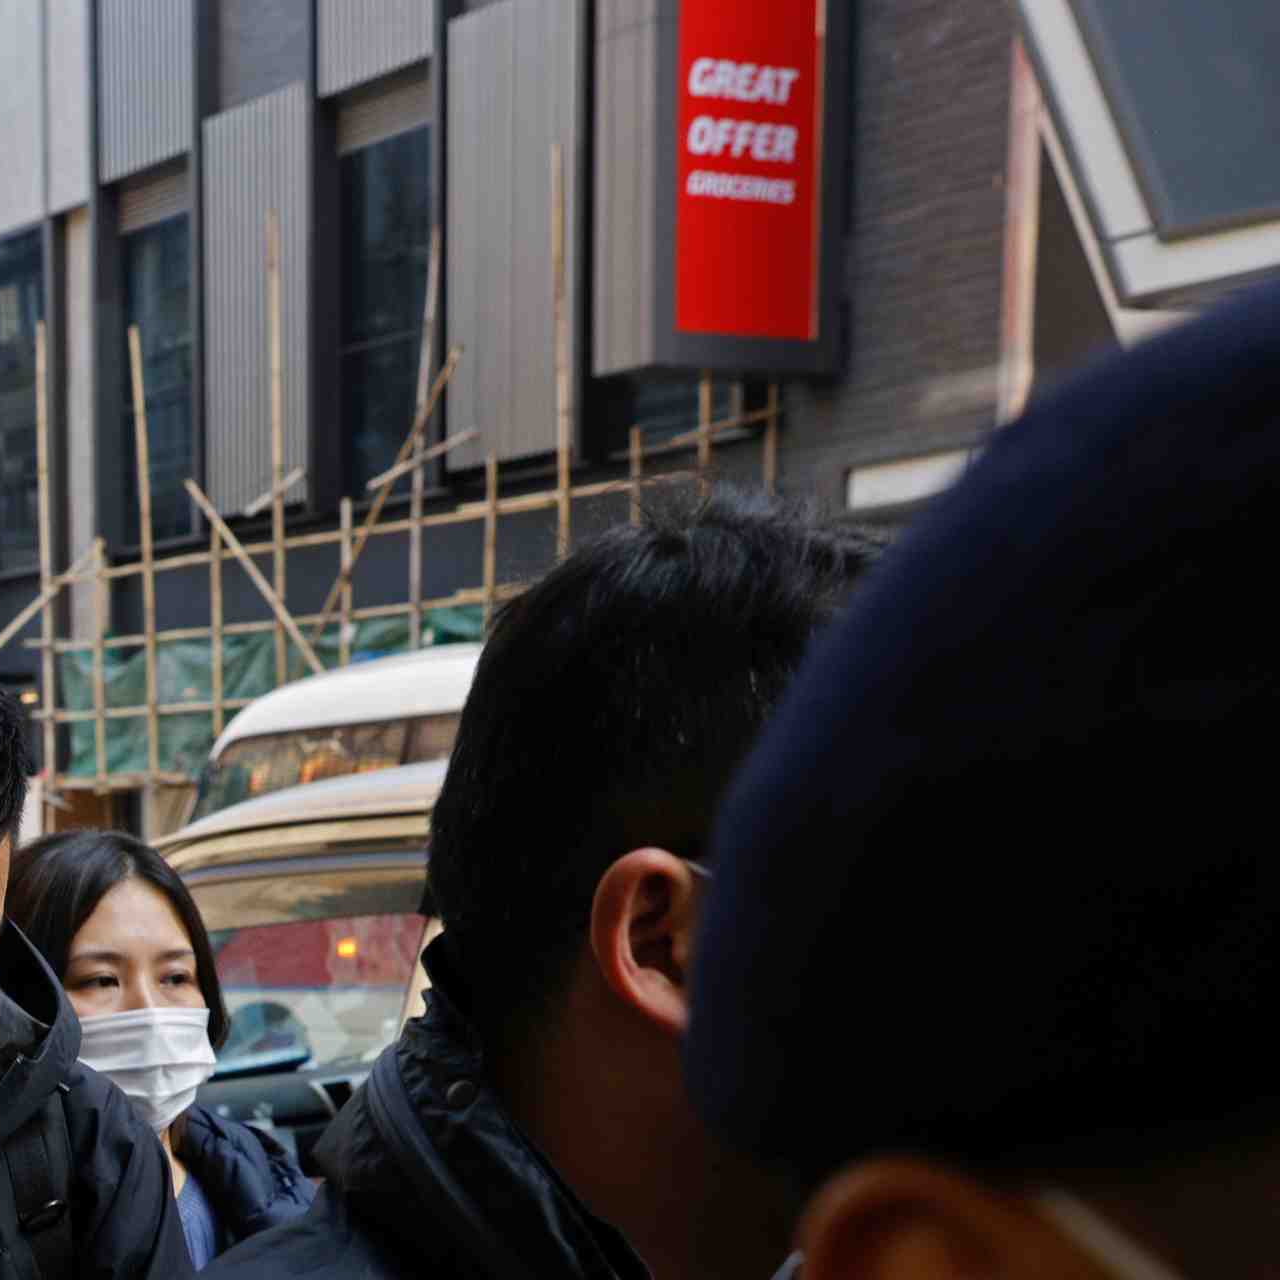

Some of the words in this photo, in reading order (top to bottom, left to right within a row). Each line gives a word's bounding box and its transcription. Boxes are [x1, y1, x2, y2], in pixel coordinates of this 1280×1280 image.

[688, 57, 800, 105] GREAT
[688, 115, 798, 163] OFFER
[686, 169, 796, 205] GROCERIES
